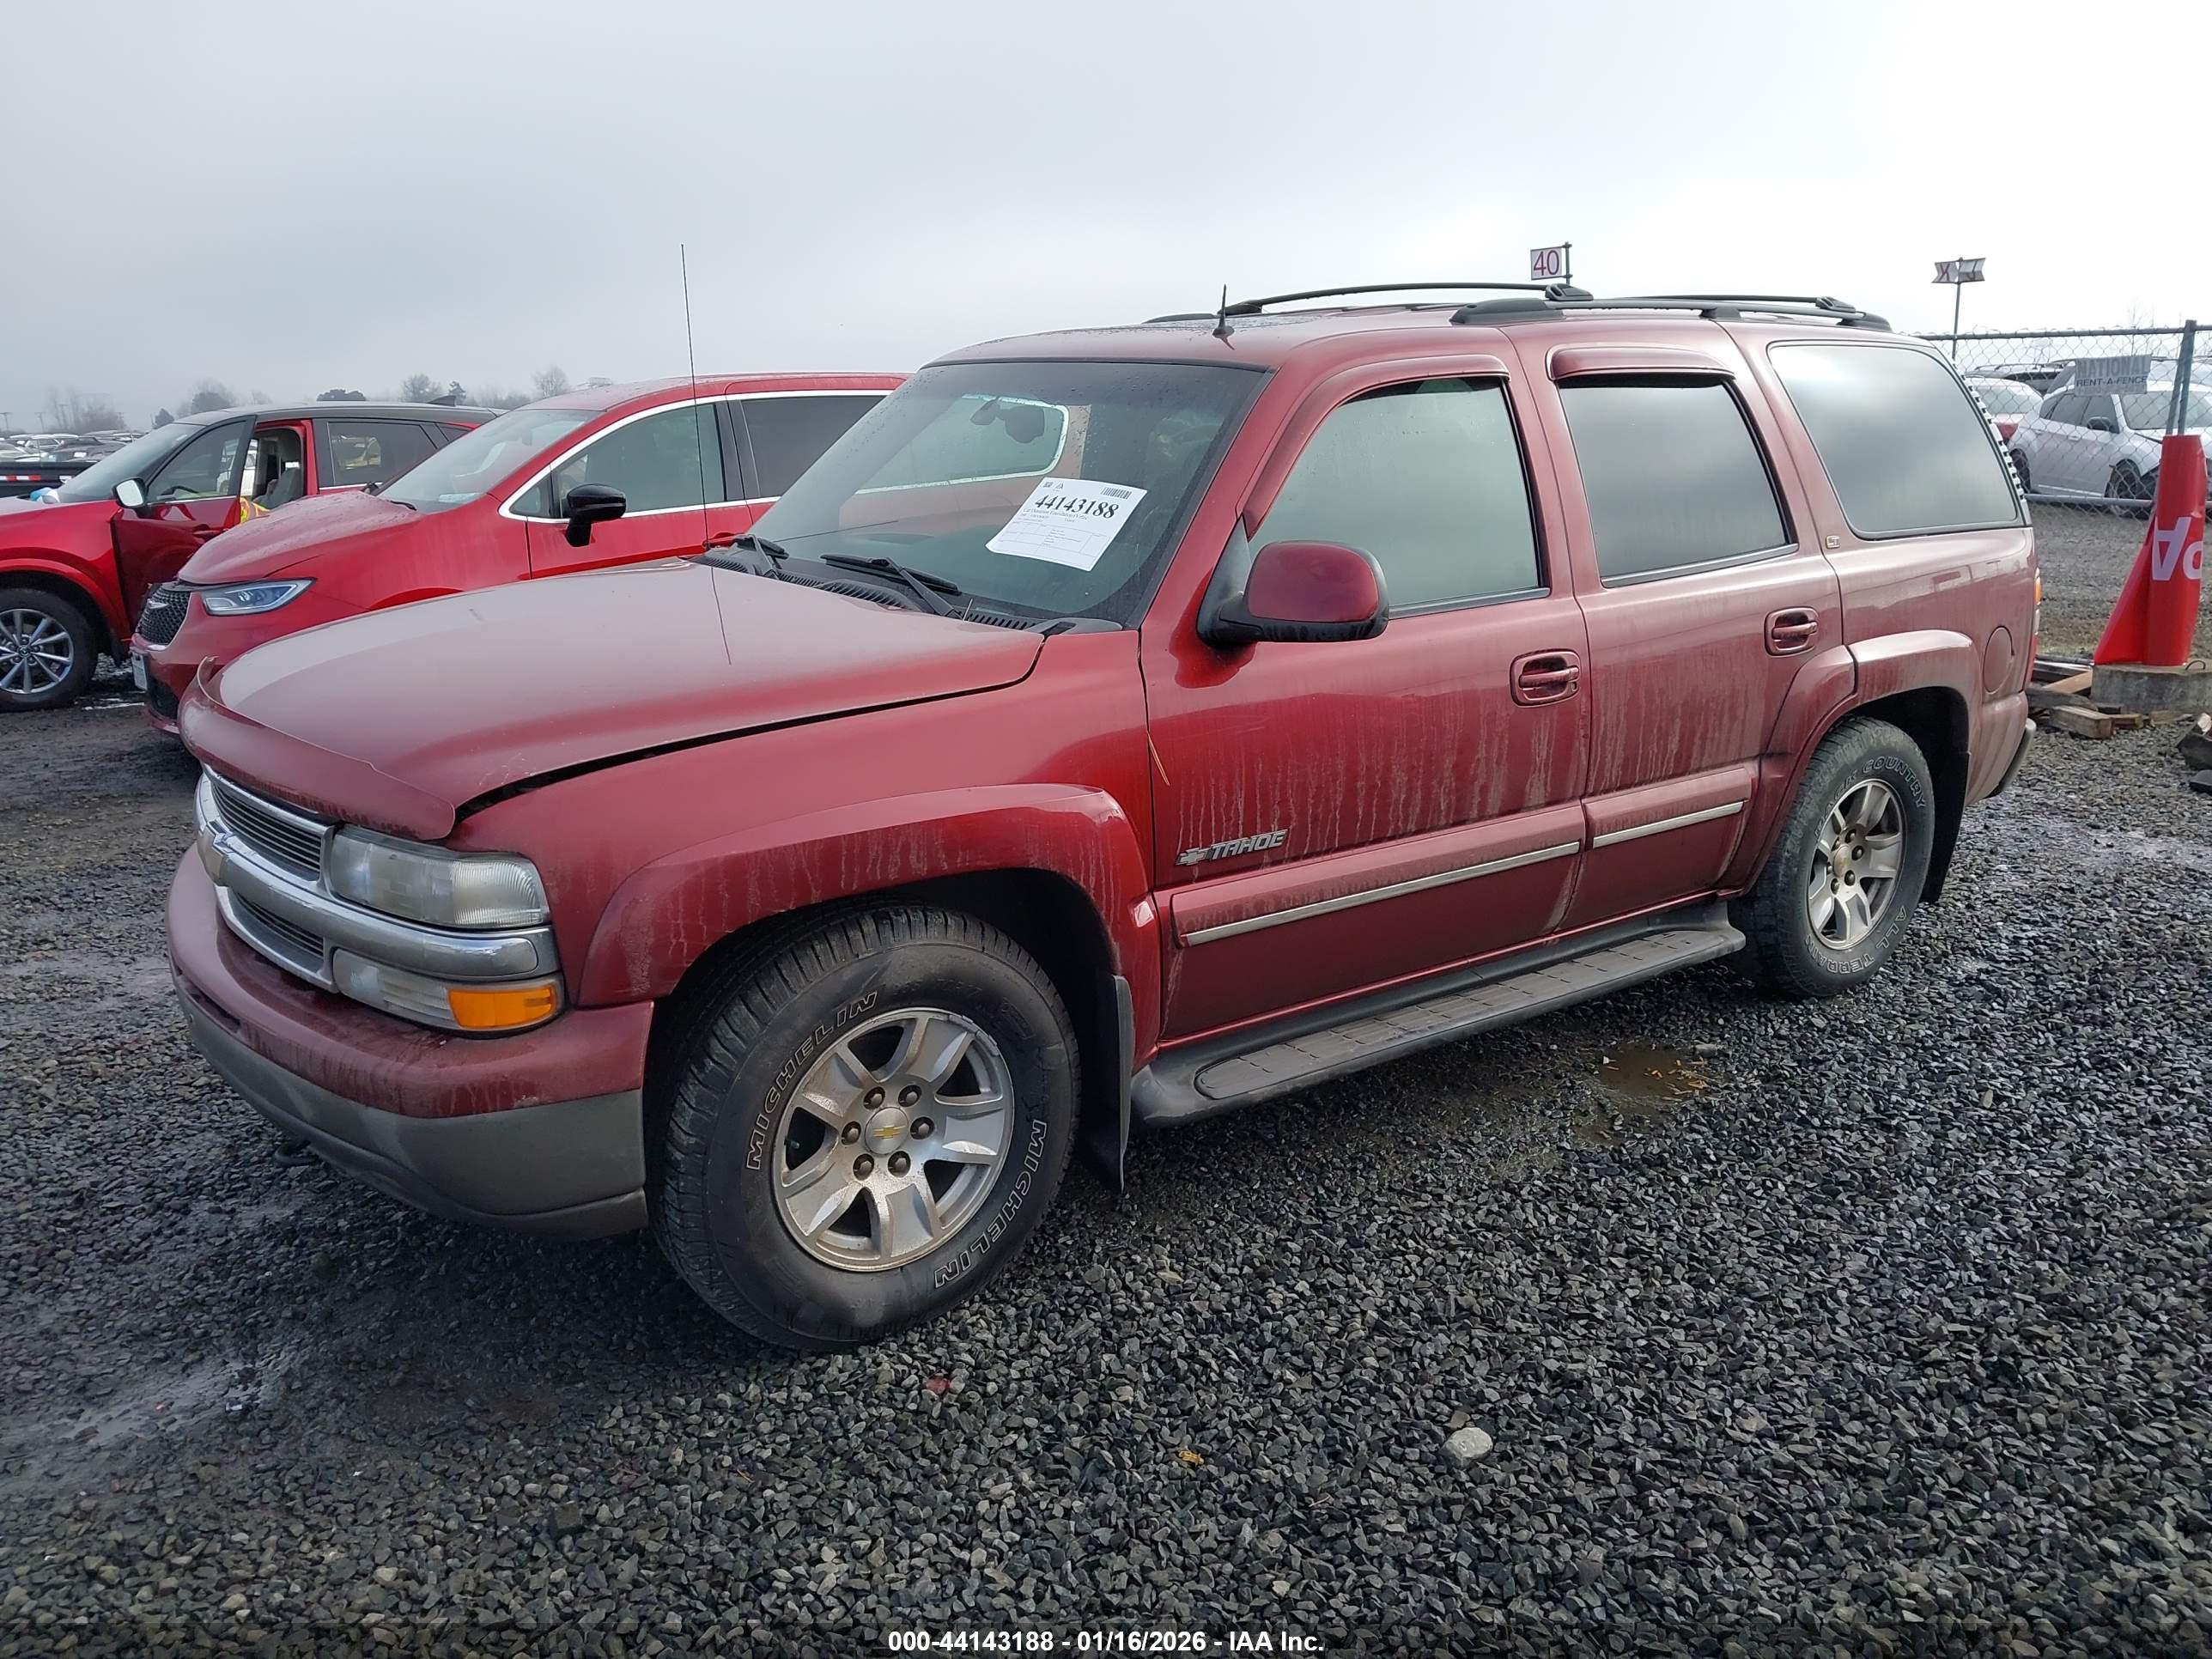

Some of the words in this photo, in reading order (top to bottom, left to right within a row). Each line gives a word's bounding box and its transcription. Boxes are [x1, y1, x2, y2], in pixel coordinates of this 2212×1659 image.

[1533, 250, 1559, 276] 40
[2076, 357, 2149, 377] NATIONAL
[2076, 375, 2147, 386] RENT-A-FENCE
[1034, 495, 1120, 520] 44143188
[1863, 756, 1926, 807] COUNTRY
[1210, 829, 1287, 860] TAHOE
[1875, 906, 1908, 949] ALL
[1805, 933, 1875, 974] TERRAIN
[746, 990, 878, 1171] MICHELIN
[933, 1120, 1048, 1290] MICHELIN
